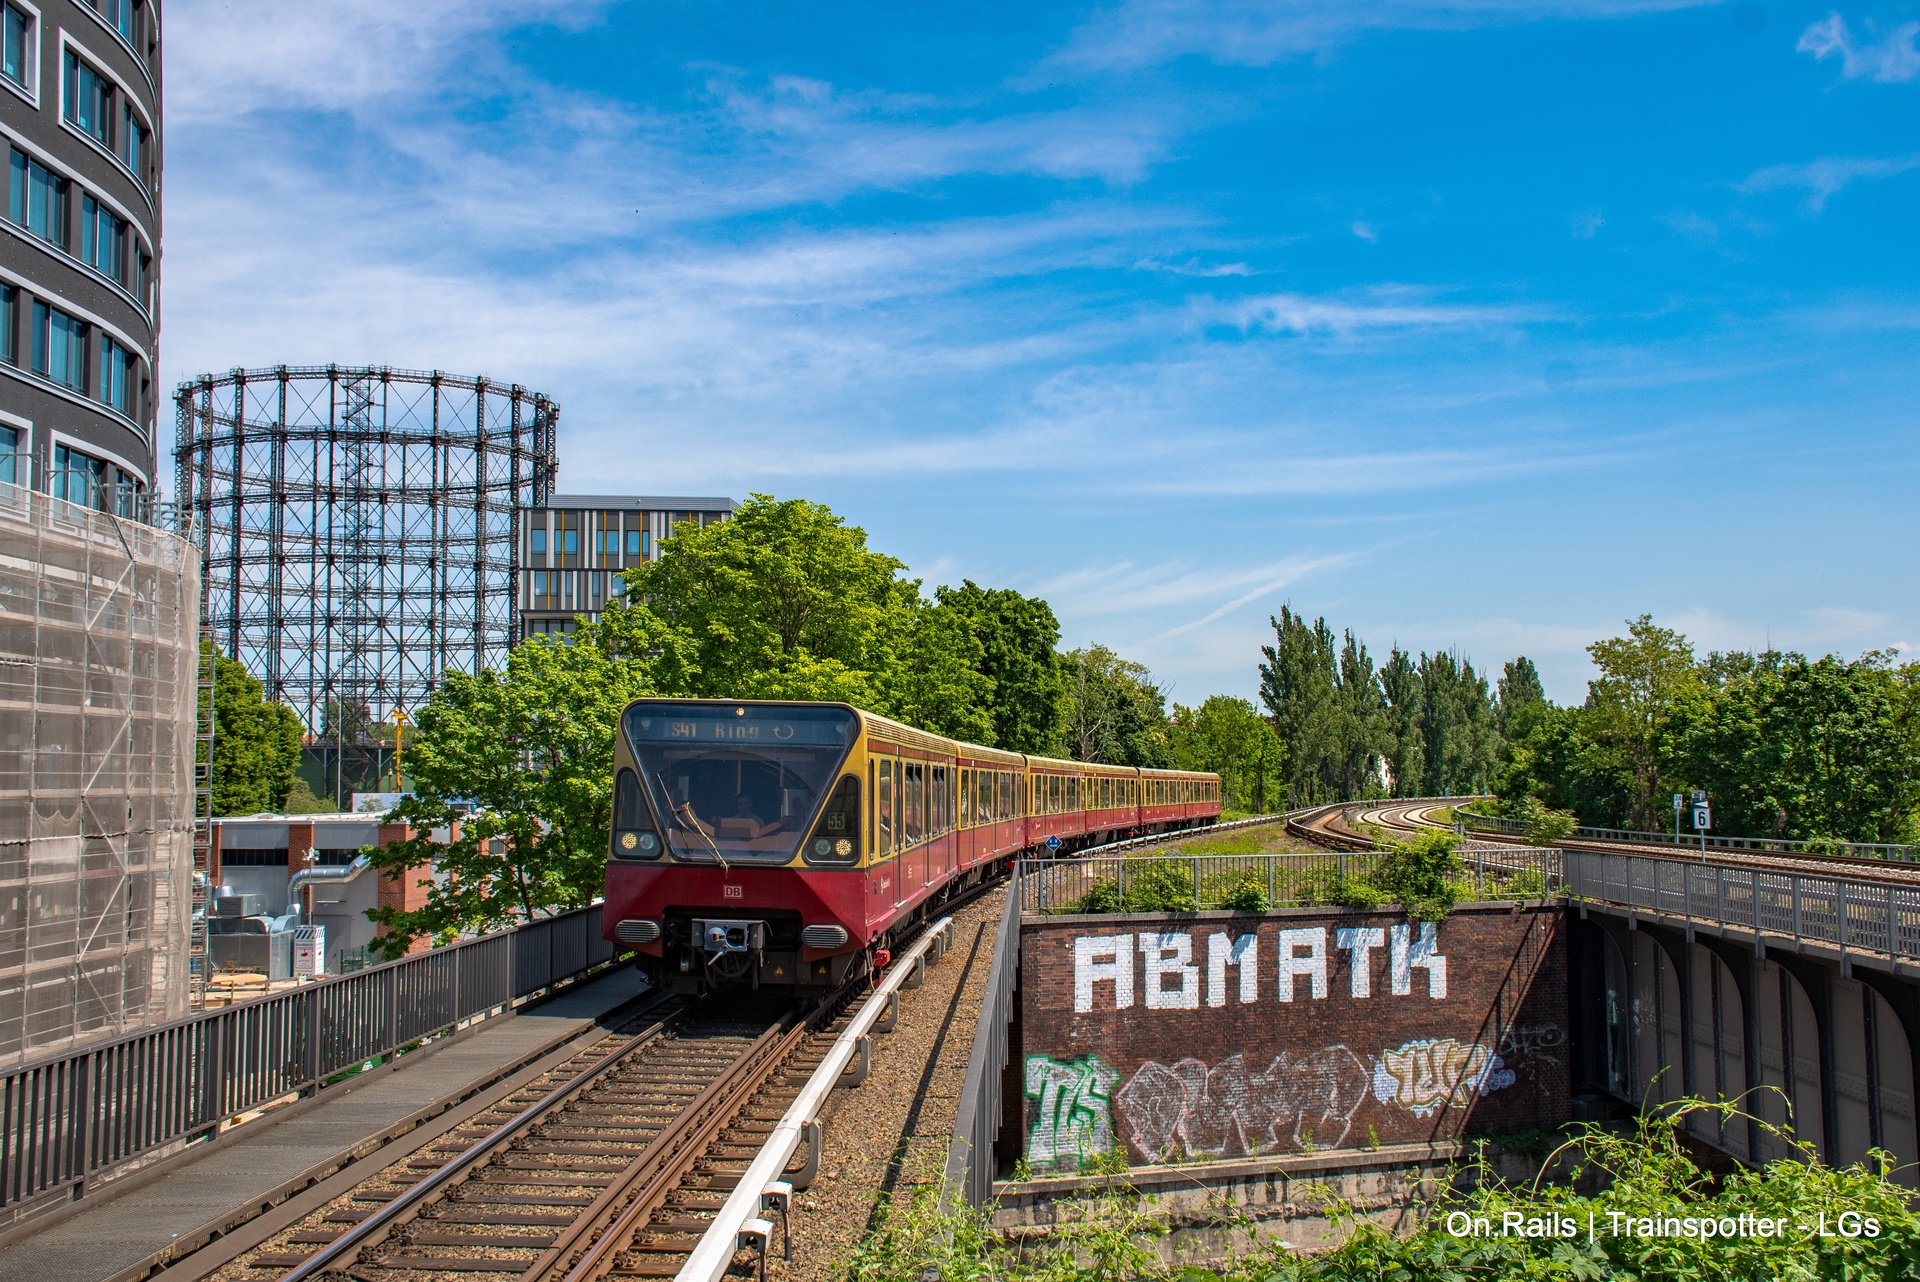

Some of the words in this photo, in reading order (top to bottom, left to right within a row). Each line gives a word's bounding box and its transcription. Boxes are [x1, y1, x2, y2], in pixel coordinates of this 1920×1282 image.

[671, 722, 697, 738] S41
[715, 723, 759, 739] Ring
[829, 813, 844, 829] 55
[1698, 811, 1706, 826] 6
[725, 886, 741, 896] DB
